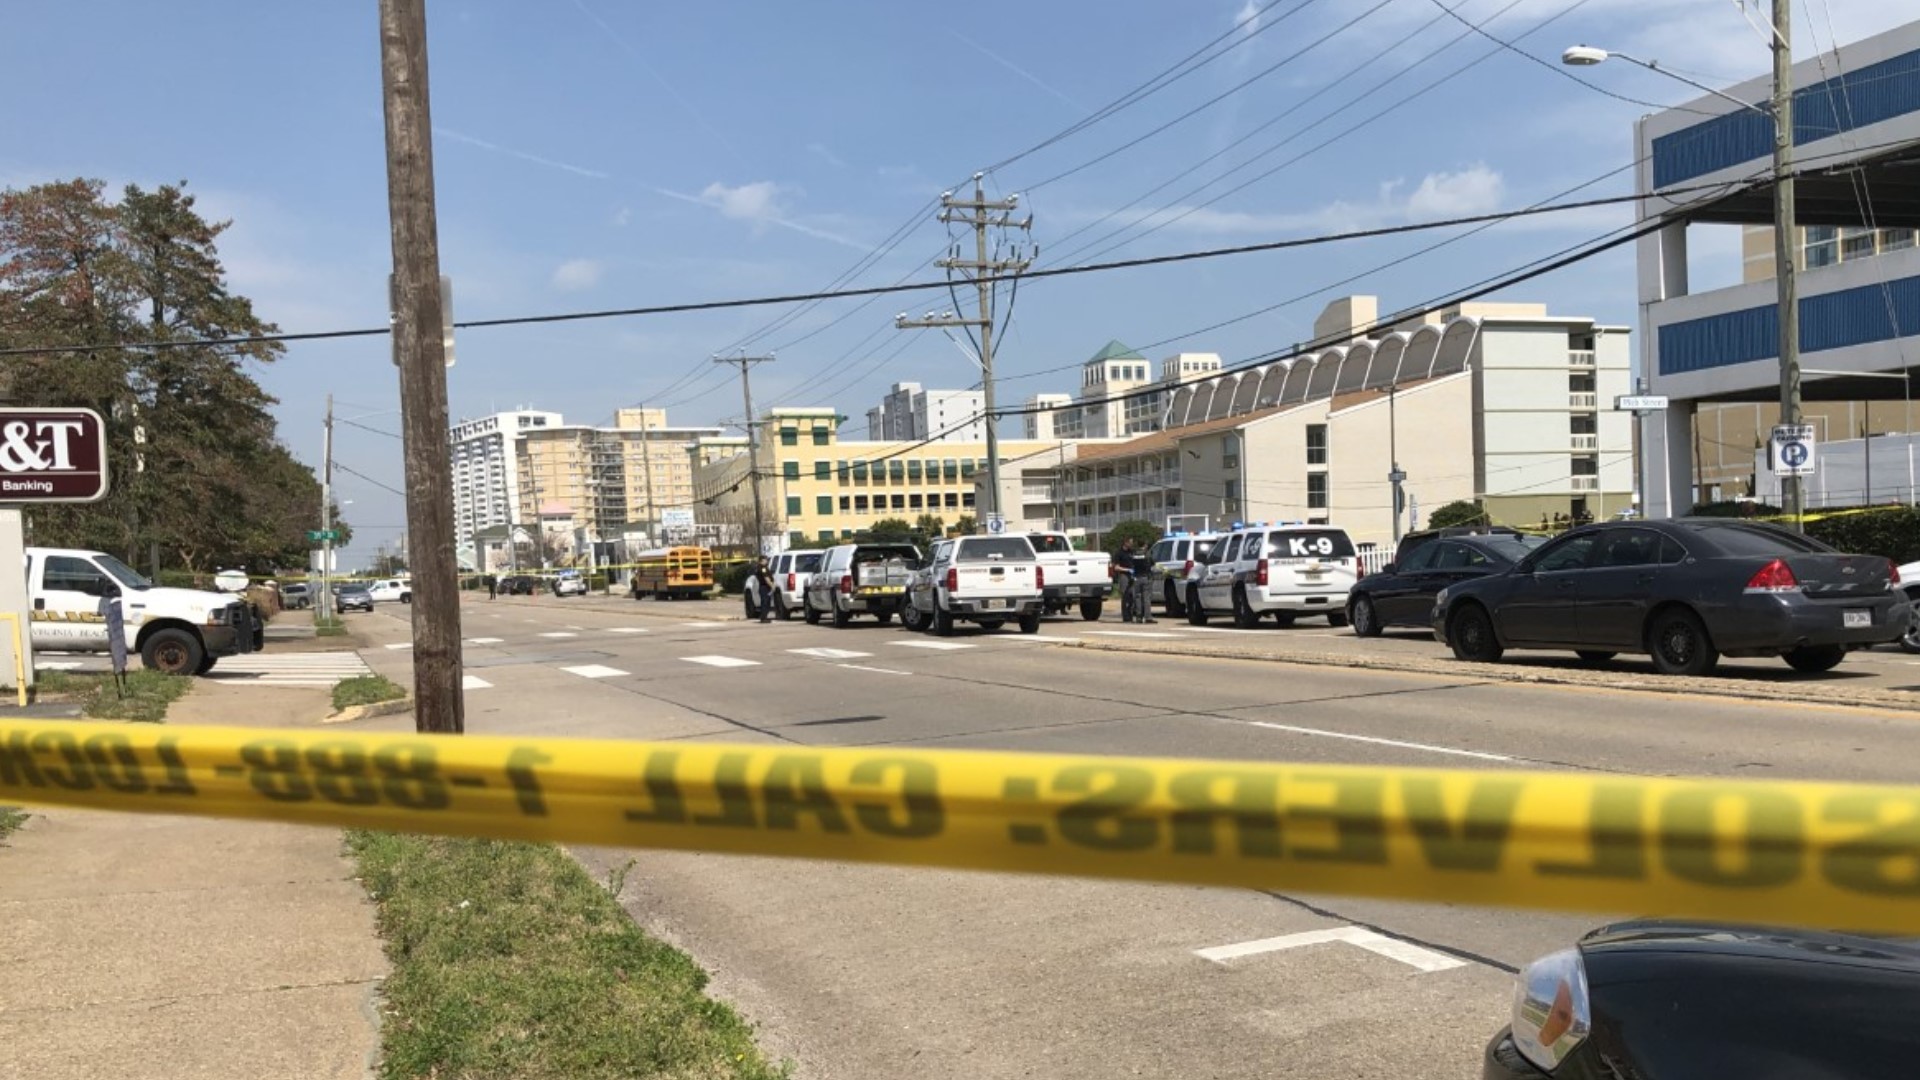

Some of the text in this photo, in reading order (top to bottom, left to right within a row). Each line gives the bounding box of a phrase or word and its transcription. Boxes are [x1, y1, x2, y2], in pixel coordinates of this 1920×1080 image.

[0, 421, 83, 472] &T
[2, 480, 53, 493] Banking
[1289, 537, 1333, 556] K-9
